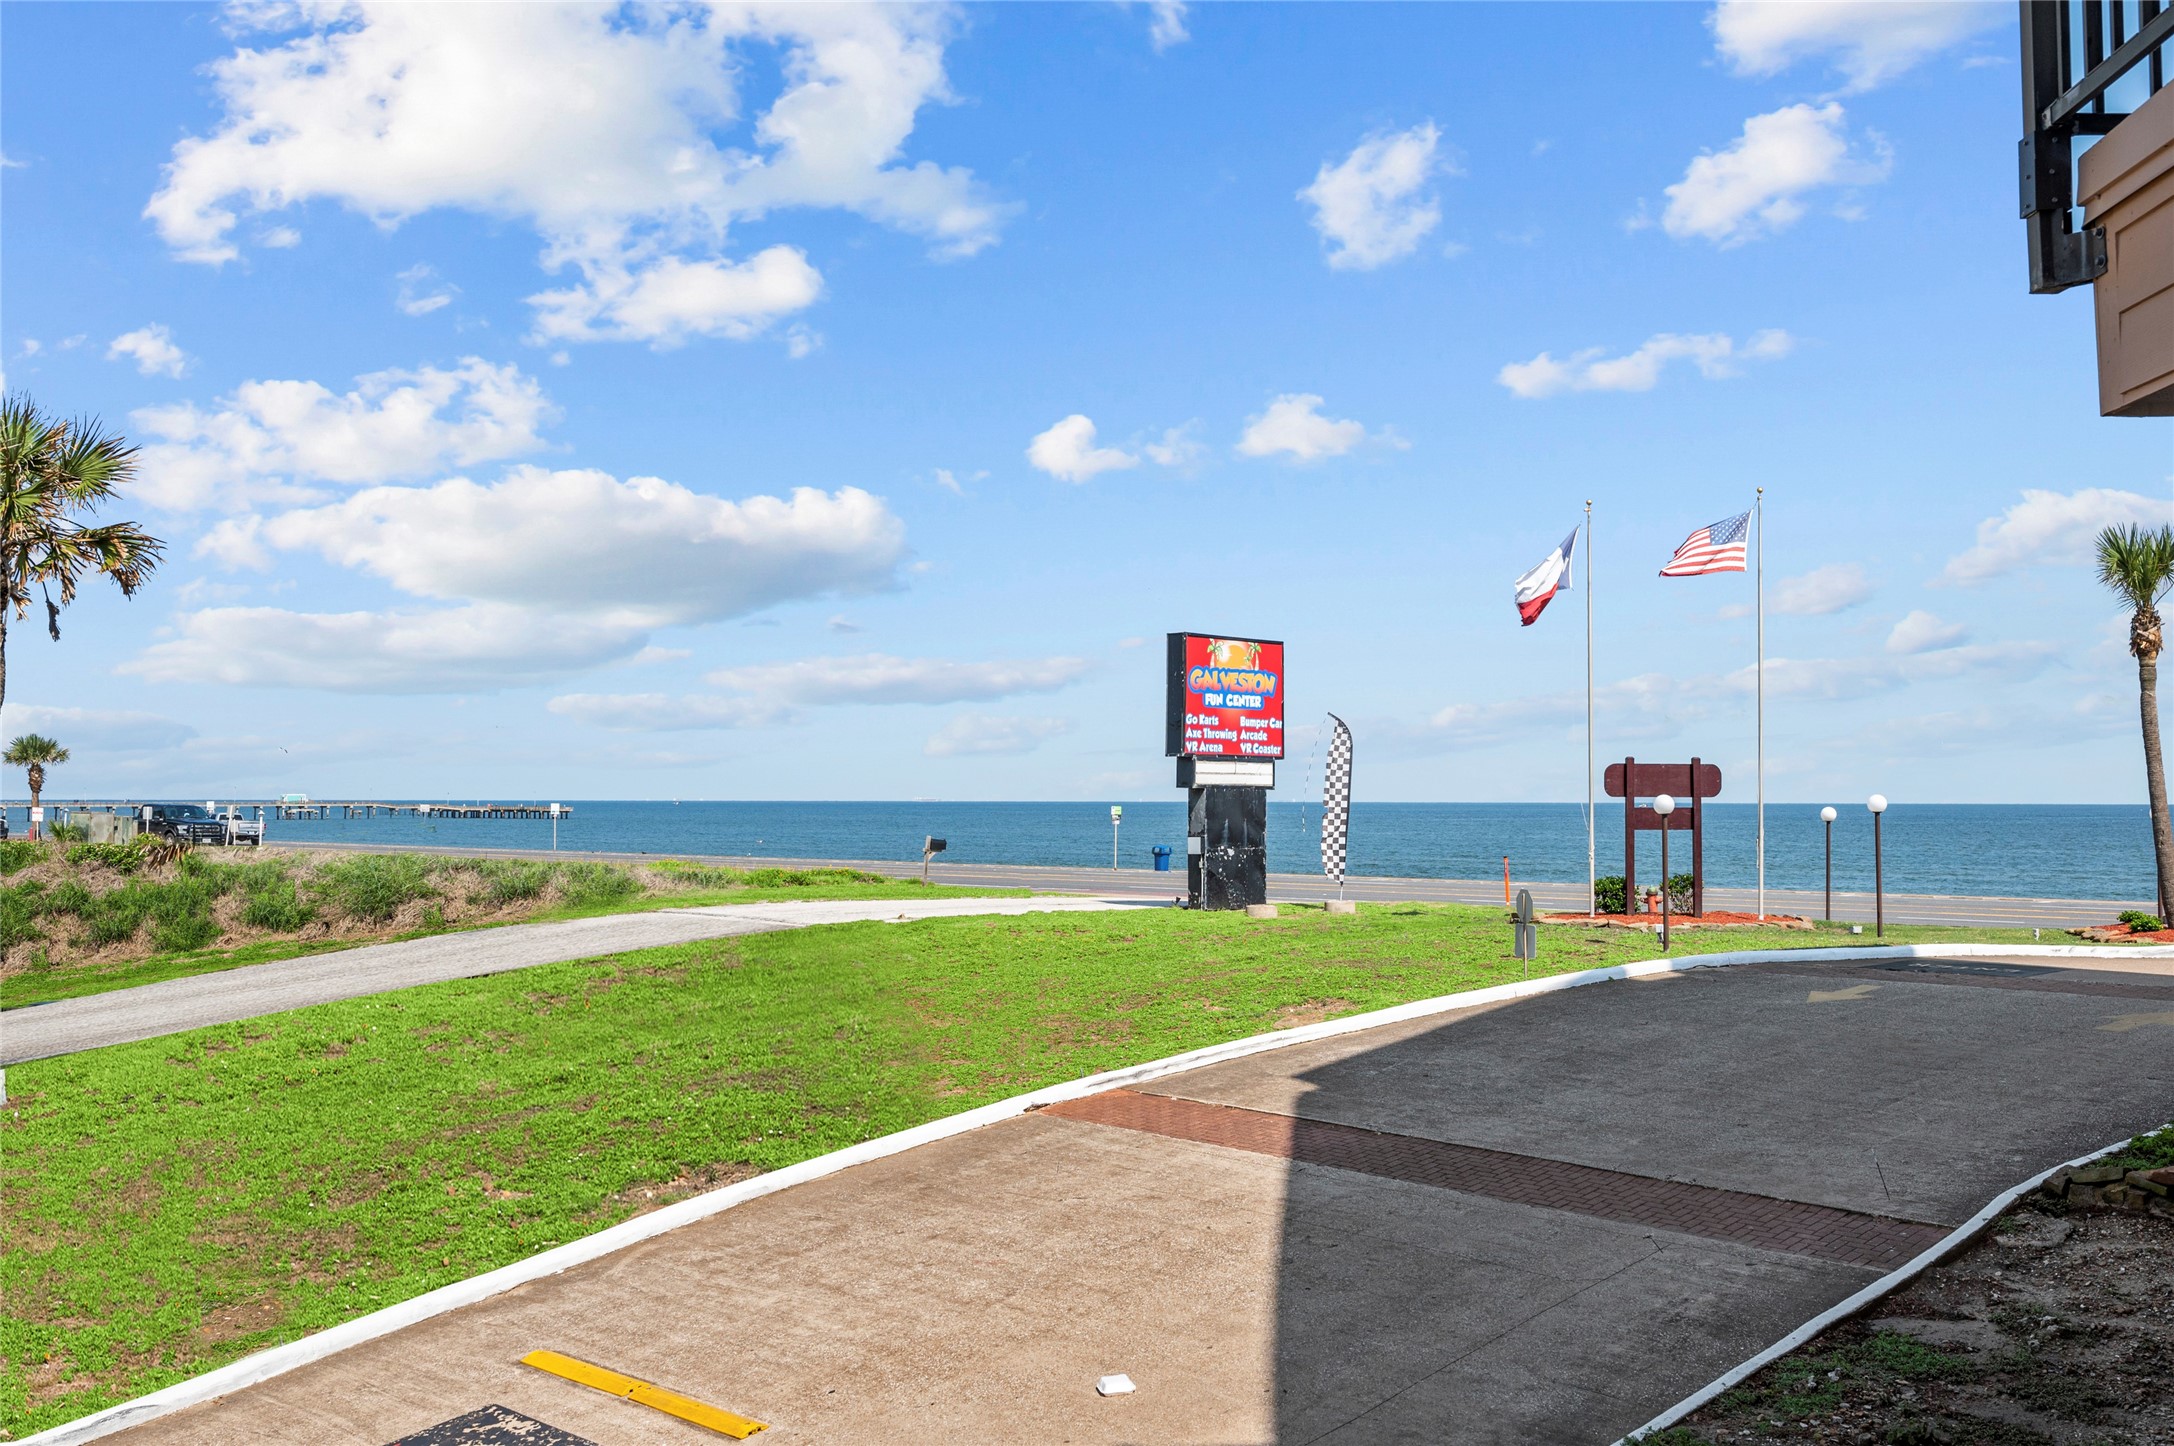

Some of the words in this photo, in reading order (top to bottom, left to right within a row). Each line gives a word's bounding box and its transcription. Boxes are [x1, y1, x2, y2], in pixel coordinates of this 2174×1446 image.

[1190, 669, 1275, 694] GALVESTON
[1205, 693, 1223, 706] FUN
[1226, 694, 1261, 708] CENTER
[1186, 714, 1198, 724] Go
[1199, 714, 1219, 725] Karts
[1240, 716, 1268, 729] Bumper
[1186, 728, 1202, 738] Axe
[1203, 728, 1236, 742] Throwing
[1240, 729, 1267, 741] Arcade
[1186, 742, 1198, 753] VR
[1199, 741, 1223, 753] Arena
[1240, 742, 1252, 754] VR
[1253, 742, 1281, 754] Coaster
